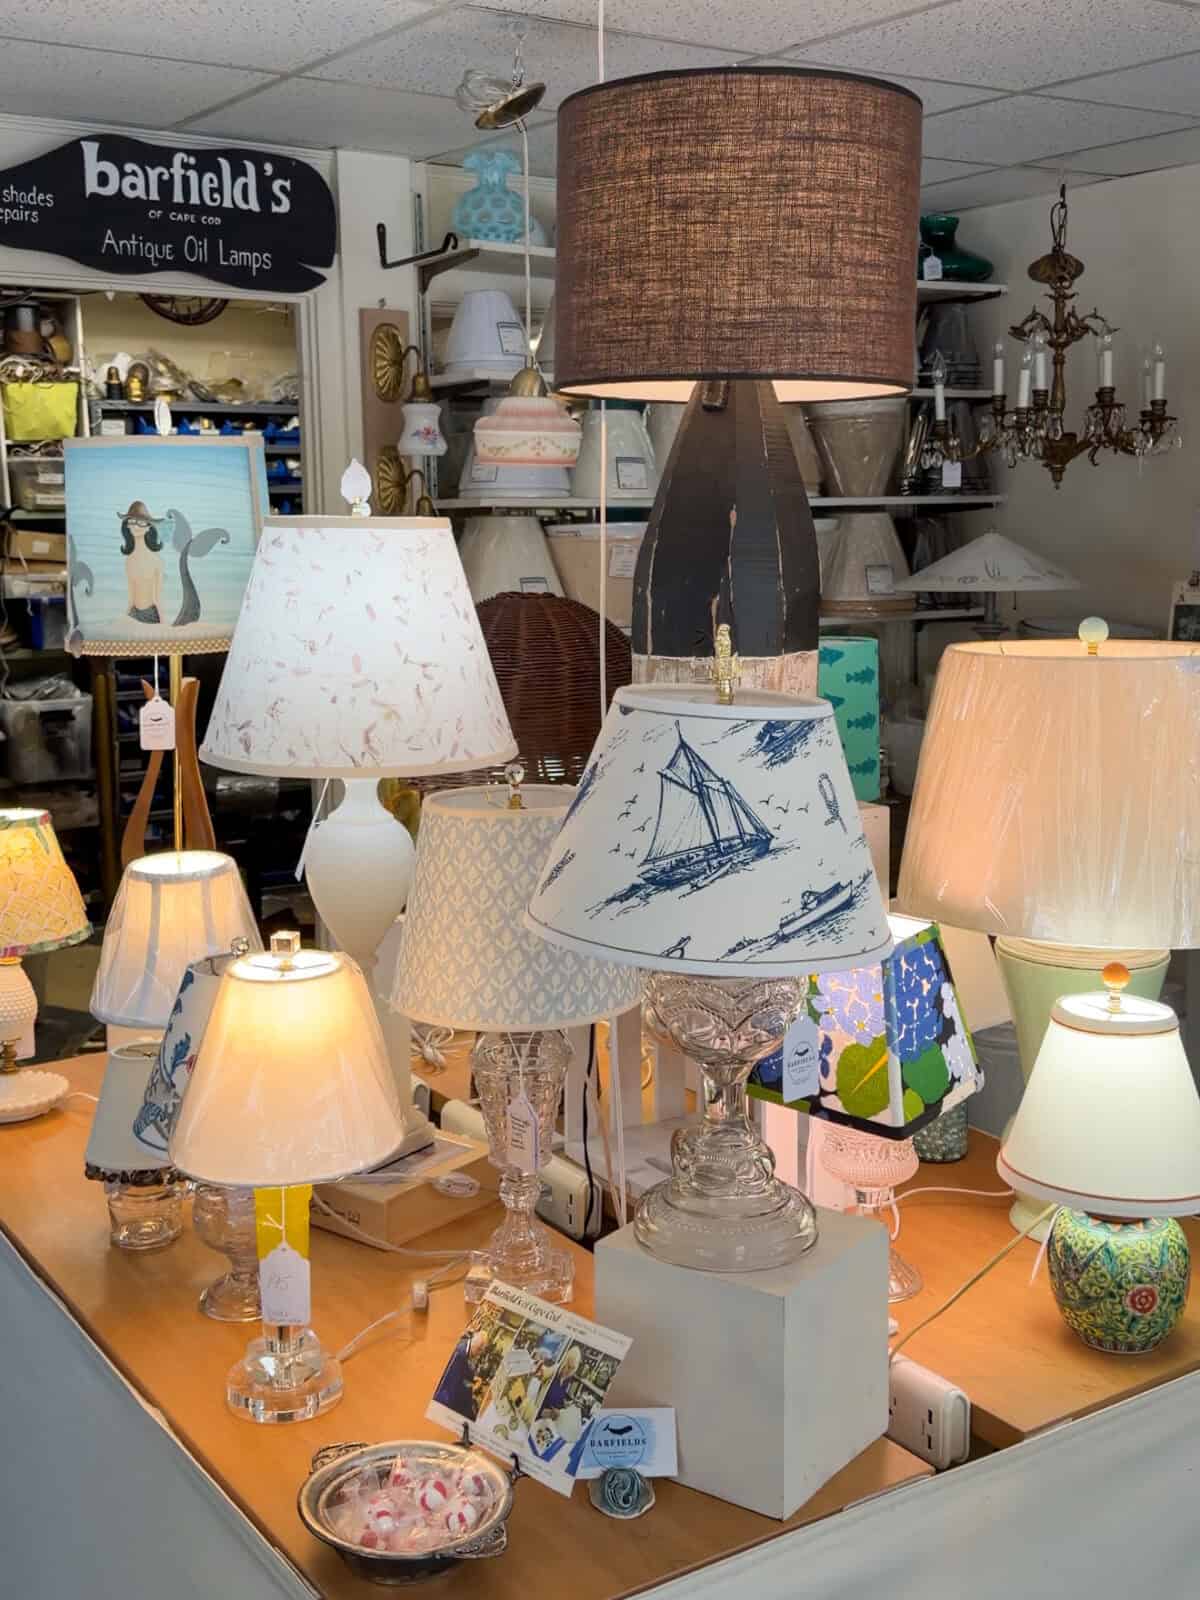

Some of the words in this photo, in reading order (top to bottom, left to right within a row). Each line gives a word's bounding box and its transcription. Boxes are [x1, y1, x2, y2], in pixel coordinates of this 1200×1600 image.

[80, 141, 291, 213] barfield's
[2, 184, 54, 207] shades
[148, 209, 163, 219] OF
[169, 211, 196, 223] CAPE
[201, 215, 221, 225] COD
[101, 229, 174, 266] Antique
[184, 235, 207, 262] Oil
[219, 239, 272, 276] Lamps
